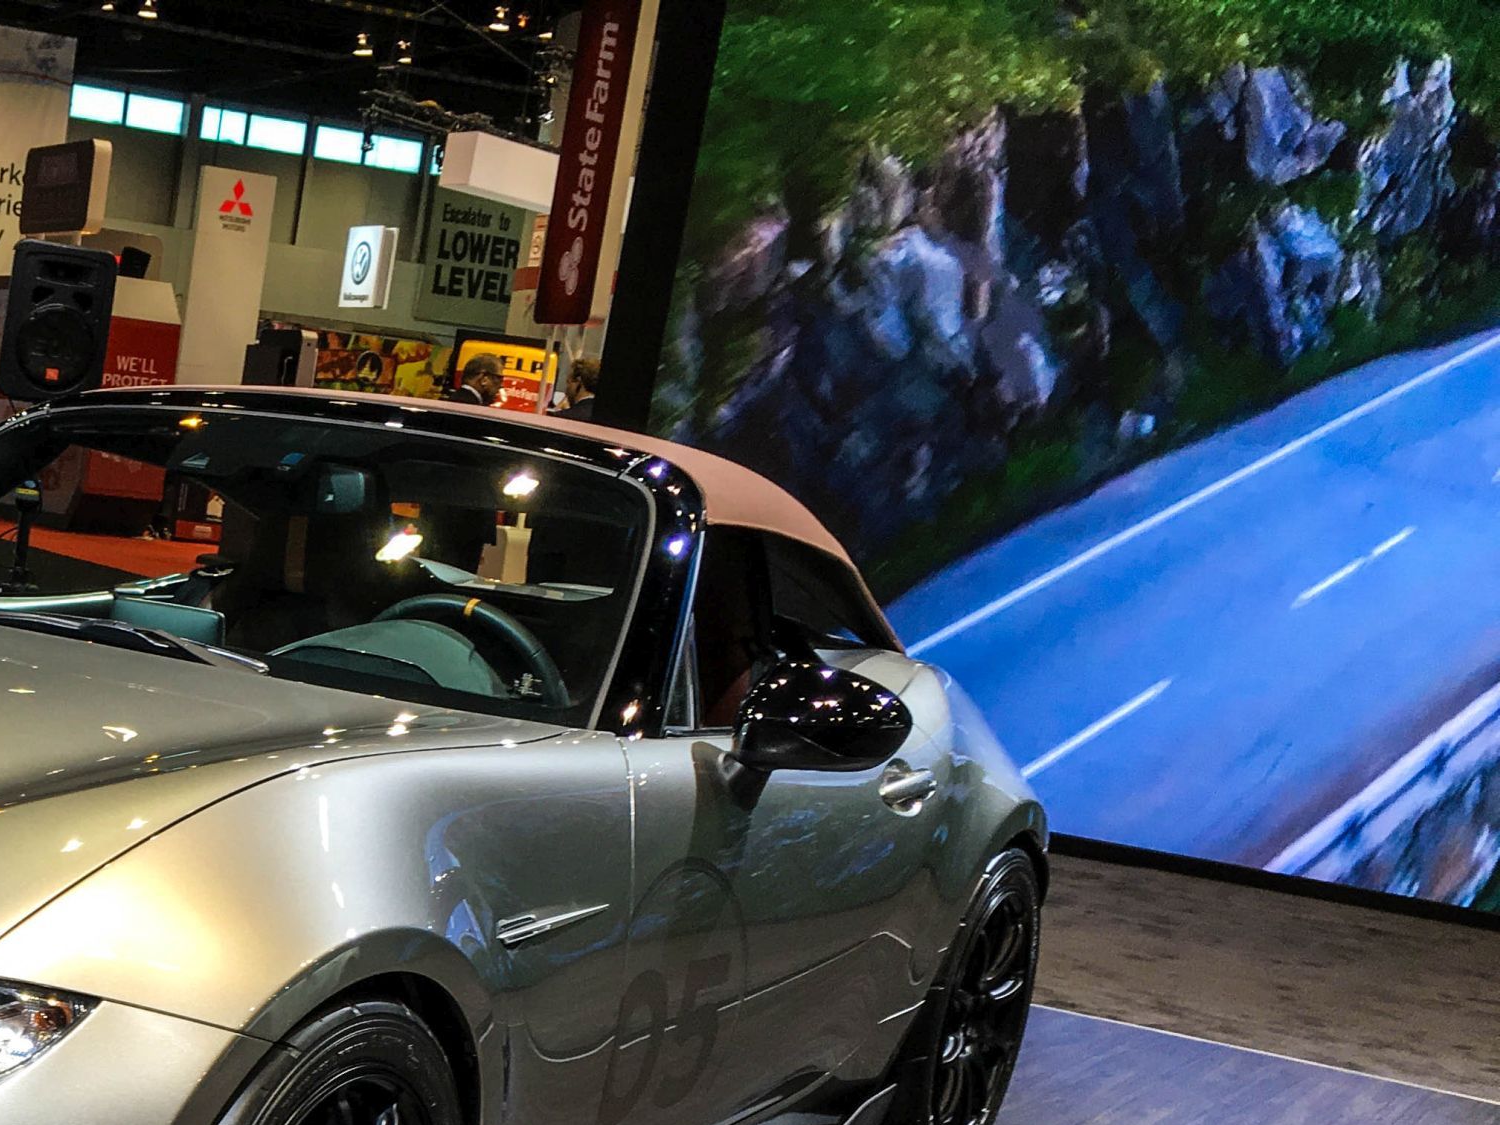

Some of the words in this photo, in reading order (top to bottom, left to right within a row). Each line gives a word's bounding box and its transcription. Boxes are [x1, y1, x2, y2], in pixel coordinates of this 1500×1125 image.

[437, 228, 521, 269] LOWER
[431, 263, 512, 304] LEVEL
[116, 355, 159, 375] WE'LL
